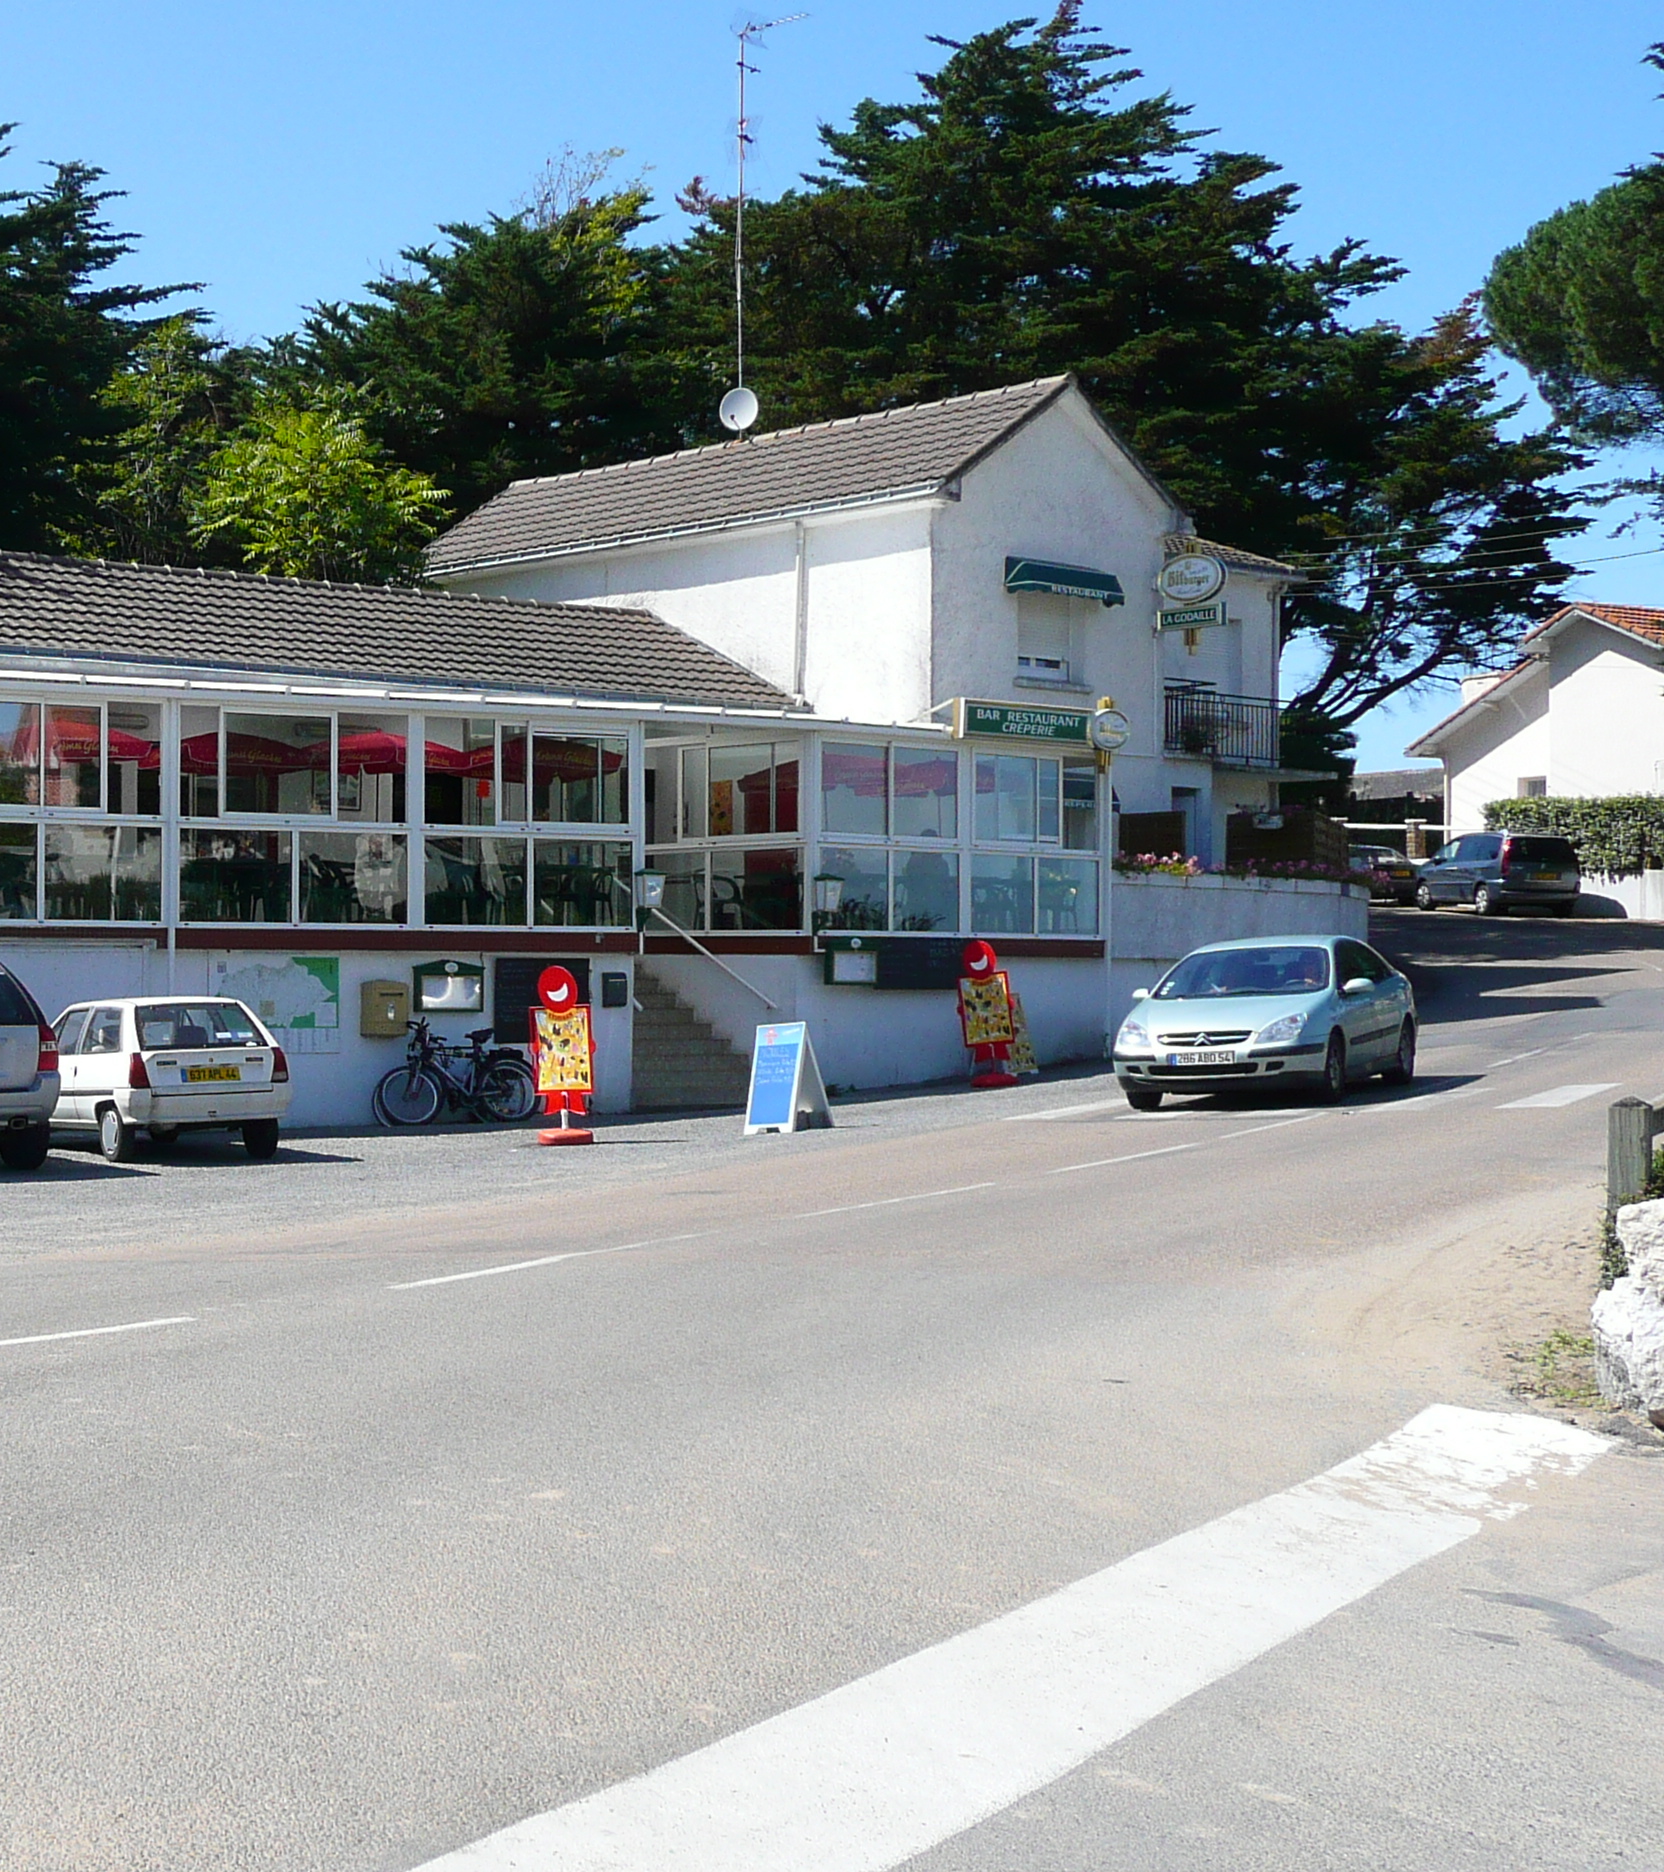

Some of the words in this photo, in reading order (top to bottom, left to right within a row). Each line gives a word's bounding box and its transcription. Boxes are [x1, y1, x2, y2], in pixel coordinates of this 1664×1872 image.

[1162, 613, 1173, 625] LA
[1174, 609, 1216, 623] GODAILLE
[976, 709, 1000, 721] BAR
[1007, 711, 1081, 728] RESTAURANT
[226, 1069, 237, 1079] 44
